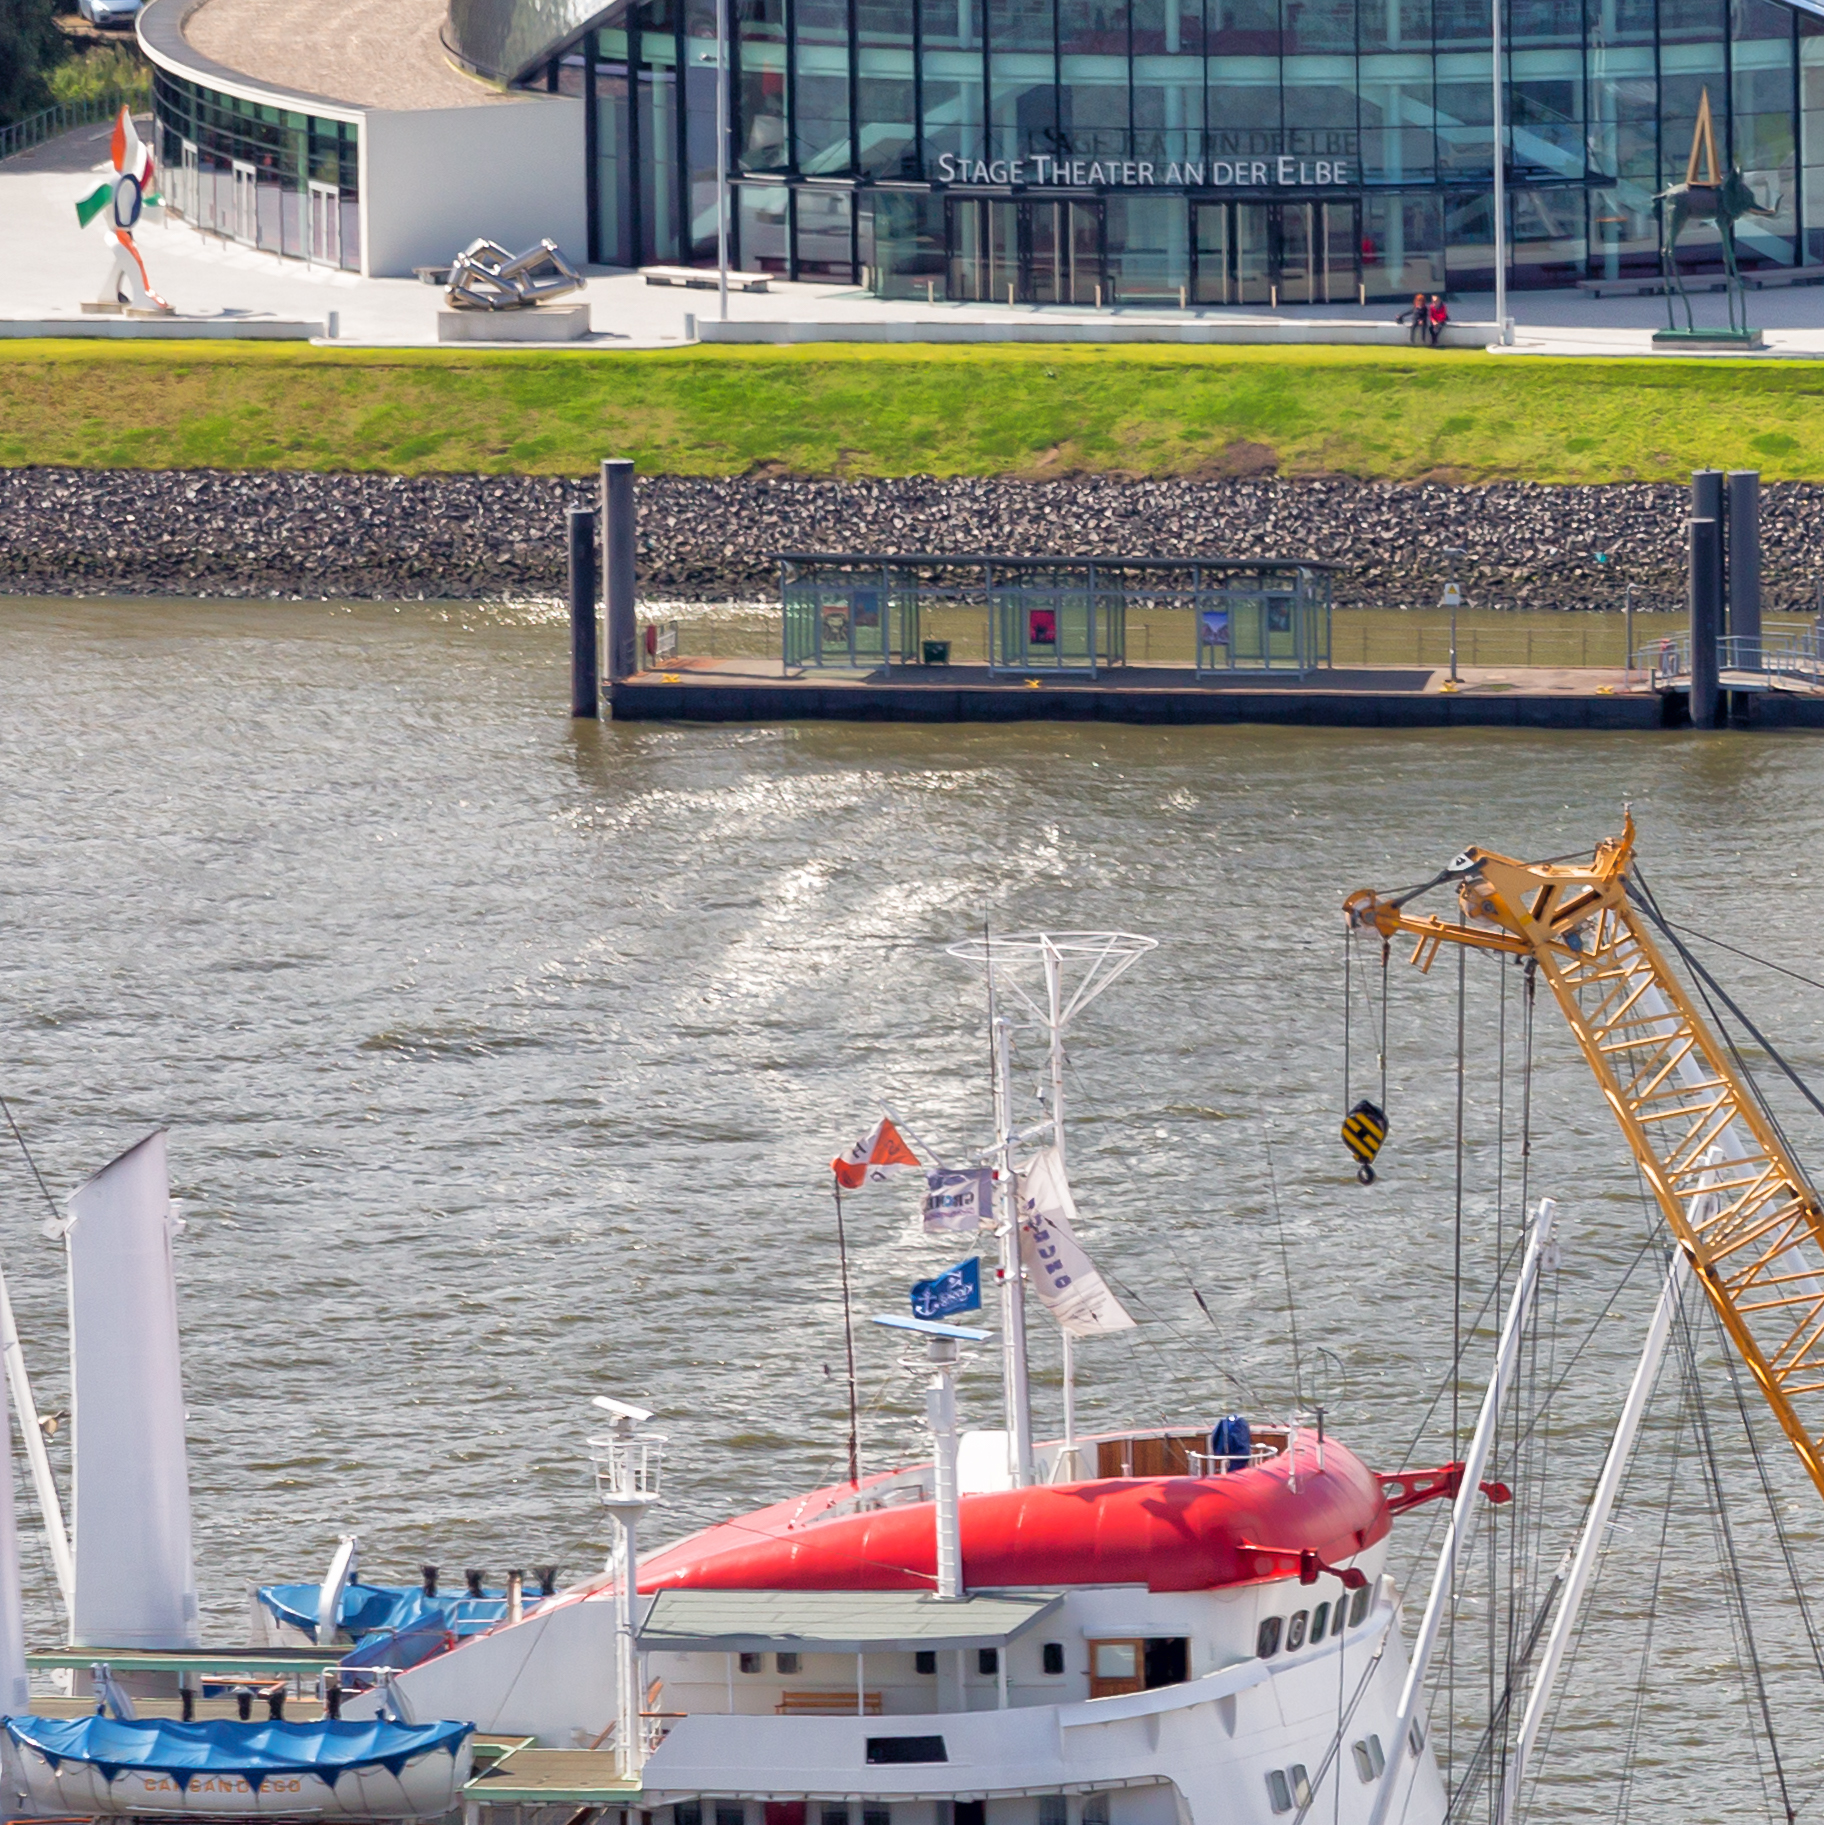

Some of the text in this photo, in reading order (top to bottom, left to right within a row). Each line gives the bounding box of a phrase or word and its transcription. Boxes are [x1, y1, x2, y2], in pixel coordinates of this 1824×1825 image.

[938, 152, 1349, 186] STAGE THEATER AN DER ELBE
